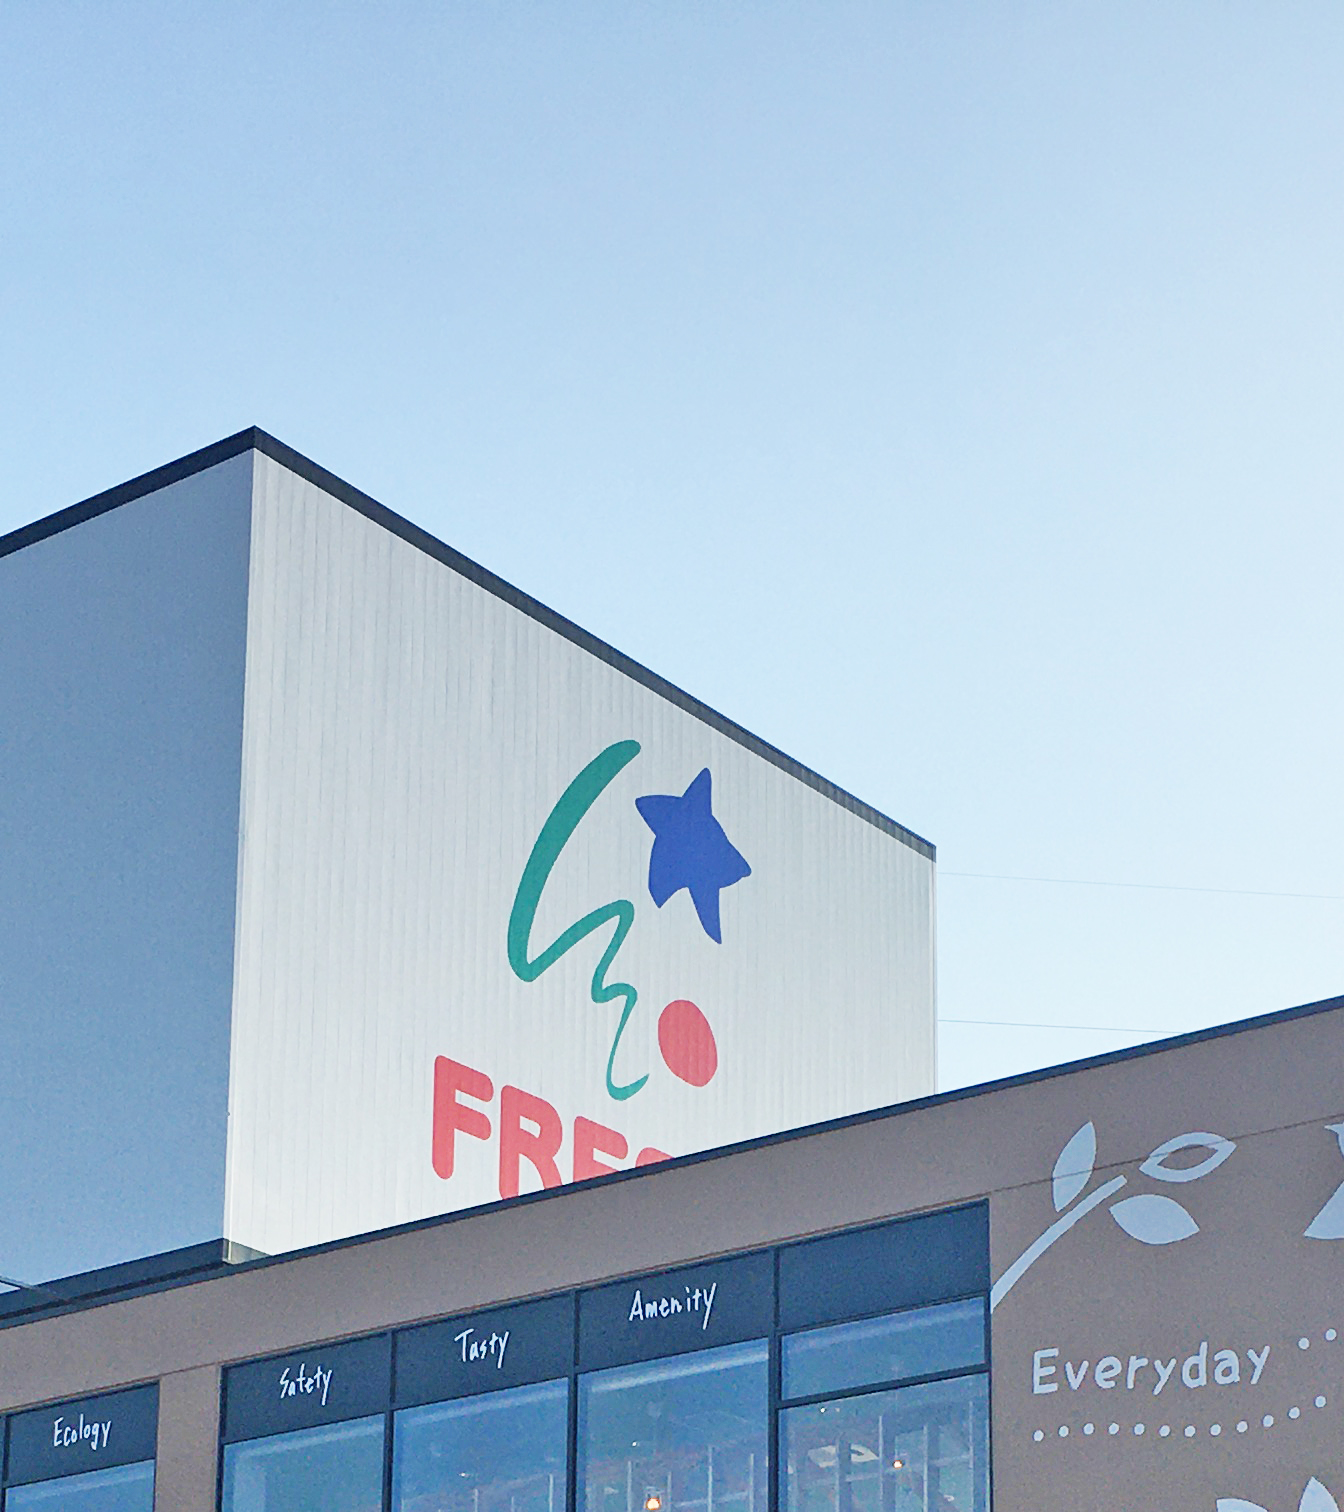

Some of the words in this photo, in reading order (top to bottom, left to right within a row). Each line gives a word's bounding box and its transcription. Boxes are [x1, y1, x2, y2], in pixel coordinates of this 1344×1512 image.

[629, 1282, 718, 1329] Amenity
[455, 1329, 509, 1369] Tasty
[1032, 1341, 1271, 1395] Everyday
[53, 1415, 113, 1450] Ecology
